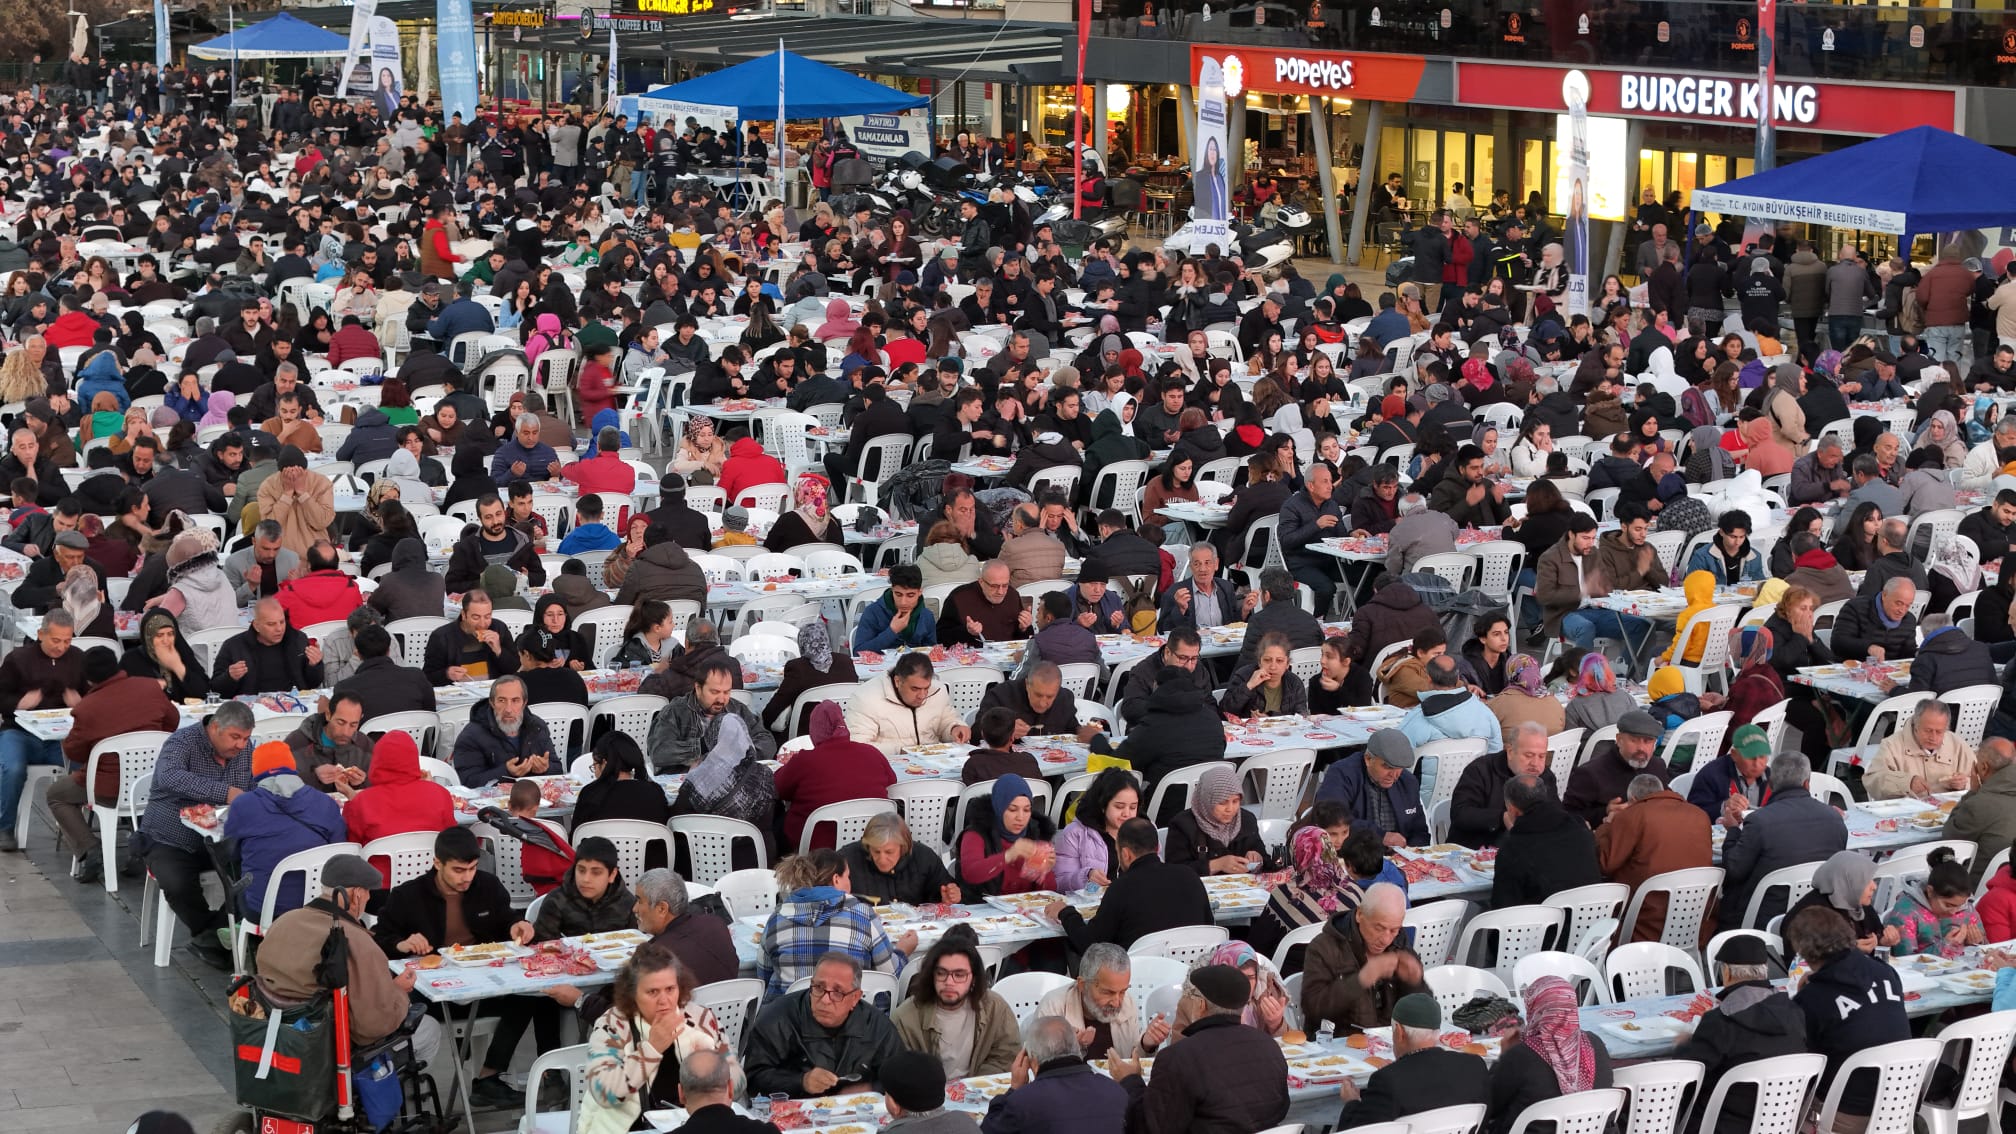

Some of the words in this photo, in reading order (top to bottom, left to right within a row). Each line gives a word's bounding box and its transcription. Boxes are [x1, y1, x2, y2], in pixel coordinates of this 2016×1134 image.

[618, 19, 642, 31] COFFEE
[649, 20, 663, 32] TEA
[1621, 74, 1733, 117] BURGER
[1740, 82, 1817, 123] KNG
[858, 131, 905, 144] RAMAZANLAR
[1729, 200, 1741, 210] T.C.
[1743, 202, 1764, 213] AYDIN
[1766, 203, 1822, 220] BÜYÜKŞEHİR
[1824, 210, 1866, 226] BELEDİYESİ
